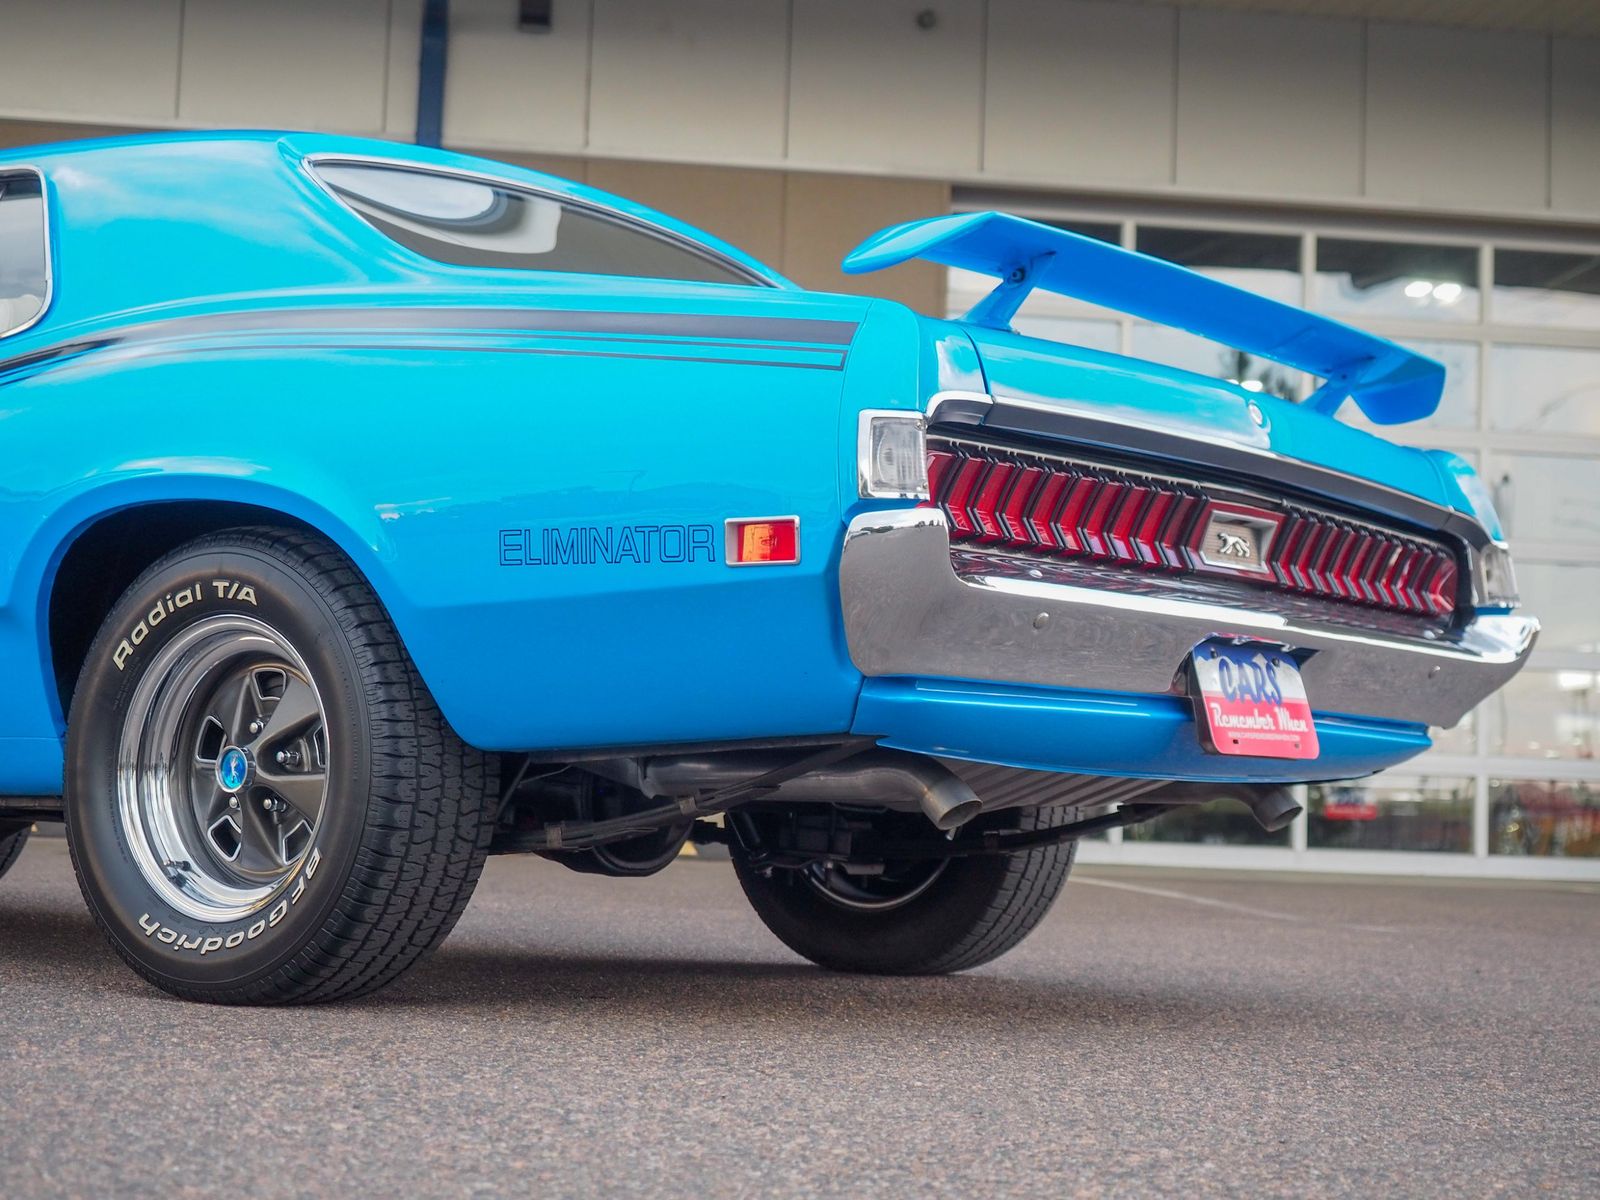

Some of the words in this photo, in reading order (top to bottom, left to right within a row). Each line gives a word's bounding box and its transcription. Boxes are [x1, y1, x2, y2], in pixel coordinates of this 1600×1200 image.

[499, 524, 716, 565] ELIMINATOR
[112, 583, 202, 671] Radial
[212, 580, 258, 606] T/A
[1218, 657, 1282, 705] CARS
[1210, 703, 1276, 731] Remember
[1274, 707, 1308, 733] When
